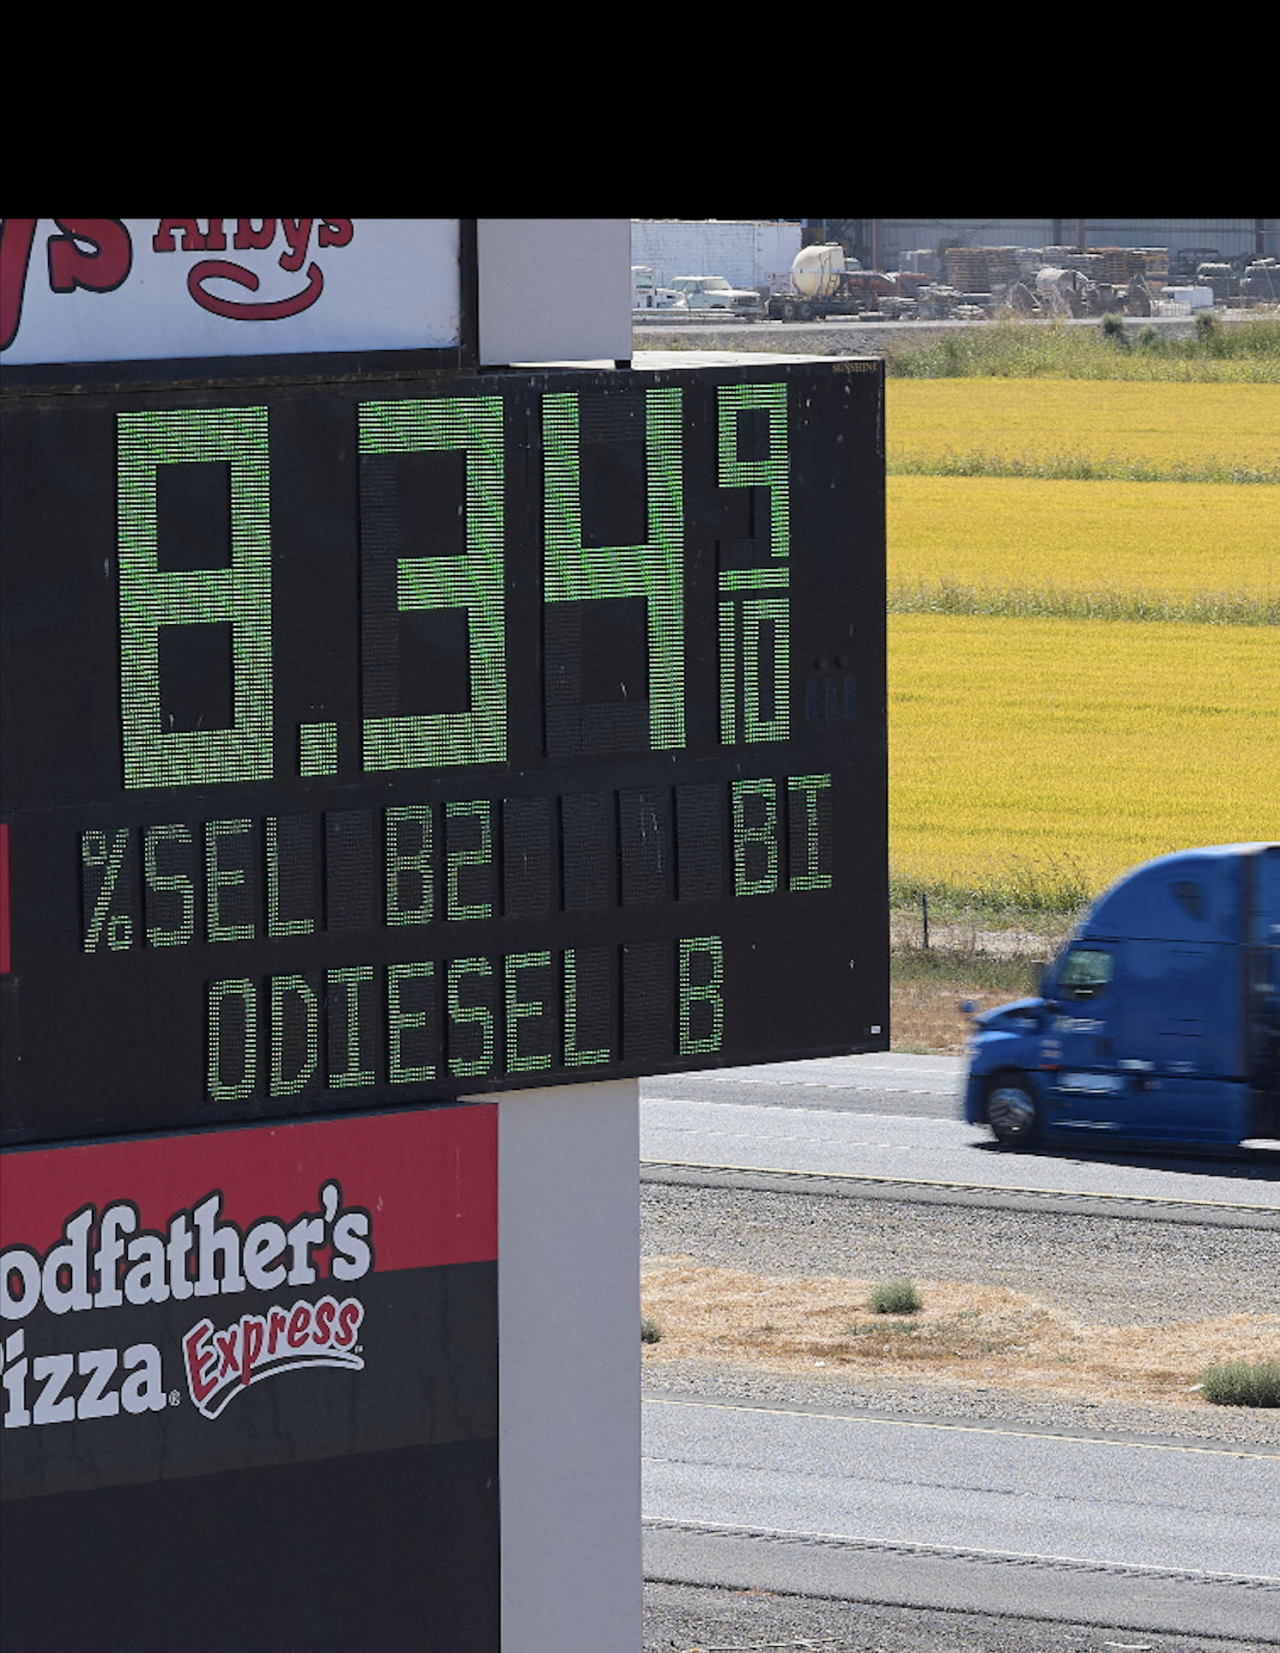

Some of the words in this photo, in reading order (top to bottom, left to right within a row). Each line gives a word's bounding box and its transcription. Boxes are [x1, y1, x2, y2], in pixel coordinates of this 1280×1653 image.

[717, 383, 790, 558] 9
[116, 387, 686, 789] 8.34
[717, 598, 791, 745] 10
[385, 800, 493, 927] B2
[679, 936, 725, 1055] B
[0, 1183, 373, 1320] odfather's
[0, 1327, 167, 1429] izza
[184, 1296, 363, 1404] Express
